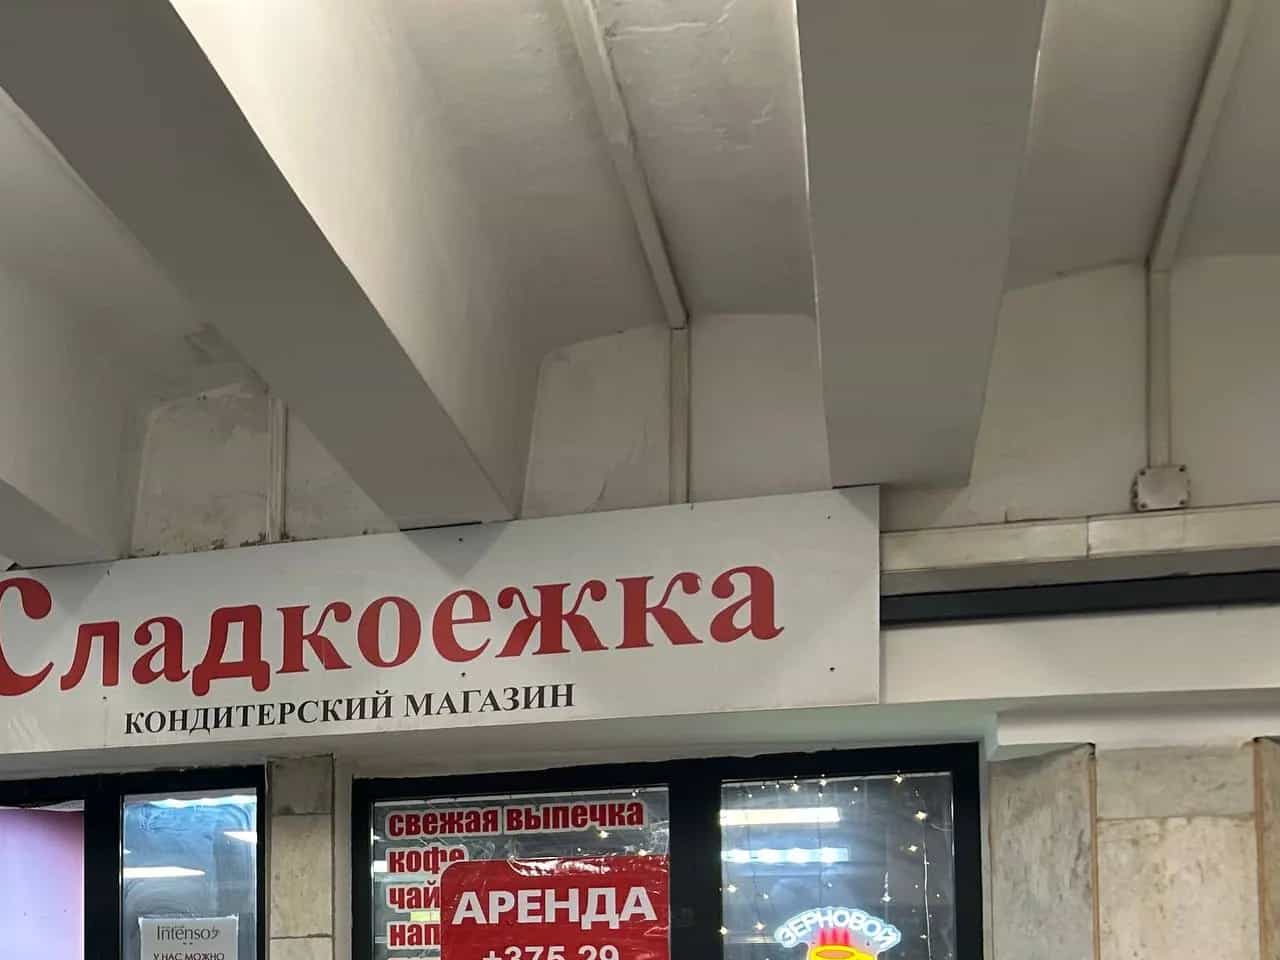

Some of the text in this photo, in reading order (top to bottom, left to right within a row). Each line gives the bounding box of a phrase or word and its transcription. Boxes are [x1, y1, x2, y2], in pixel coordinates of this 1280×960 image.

[124, 682, 576, 736] КОНДИТЕРСКИЙ МАГАЗИН
[388, 801, 645, 837] свежая выпечка
[389, 880, 440, 909] чай
[452, 886, 658, 930] АРЕНДА
[152, 952, 225, 960] У НАС МОЖНО
